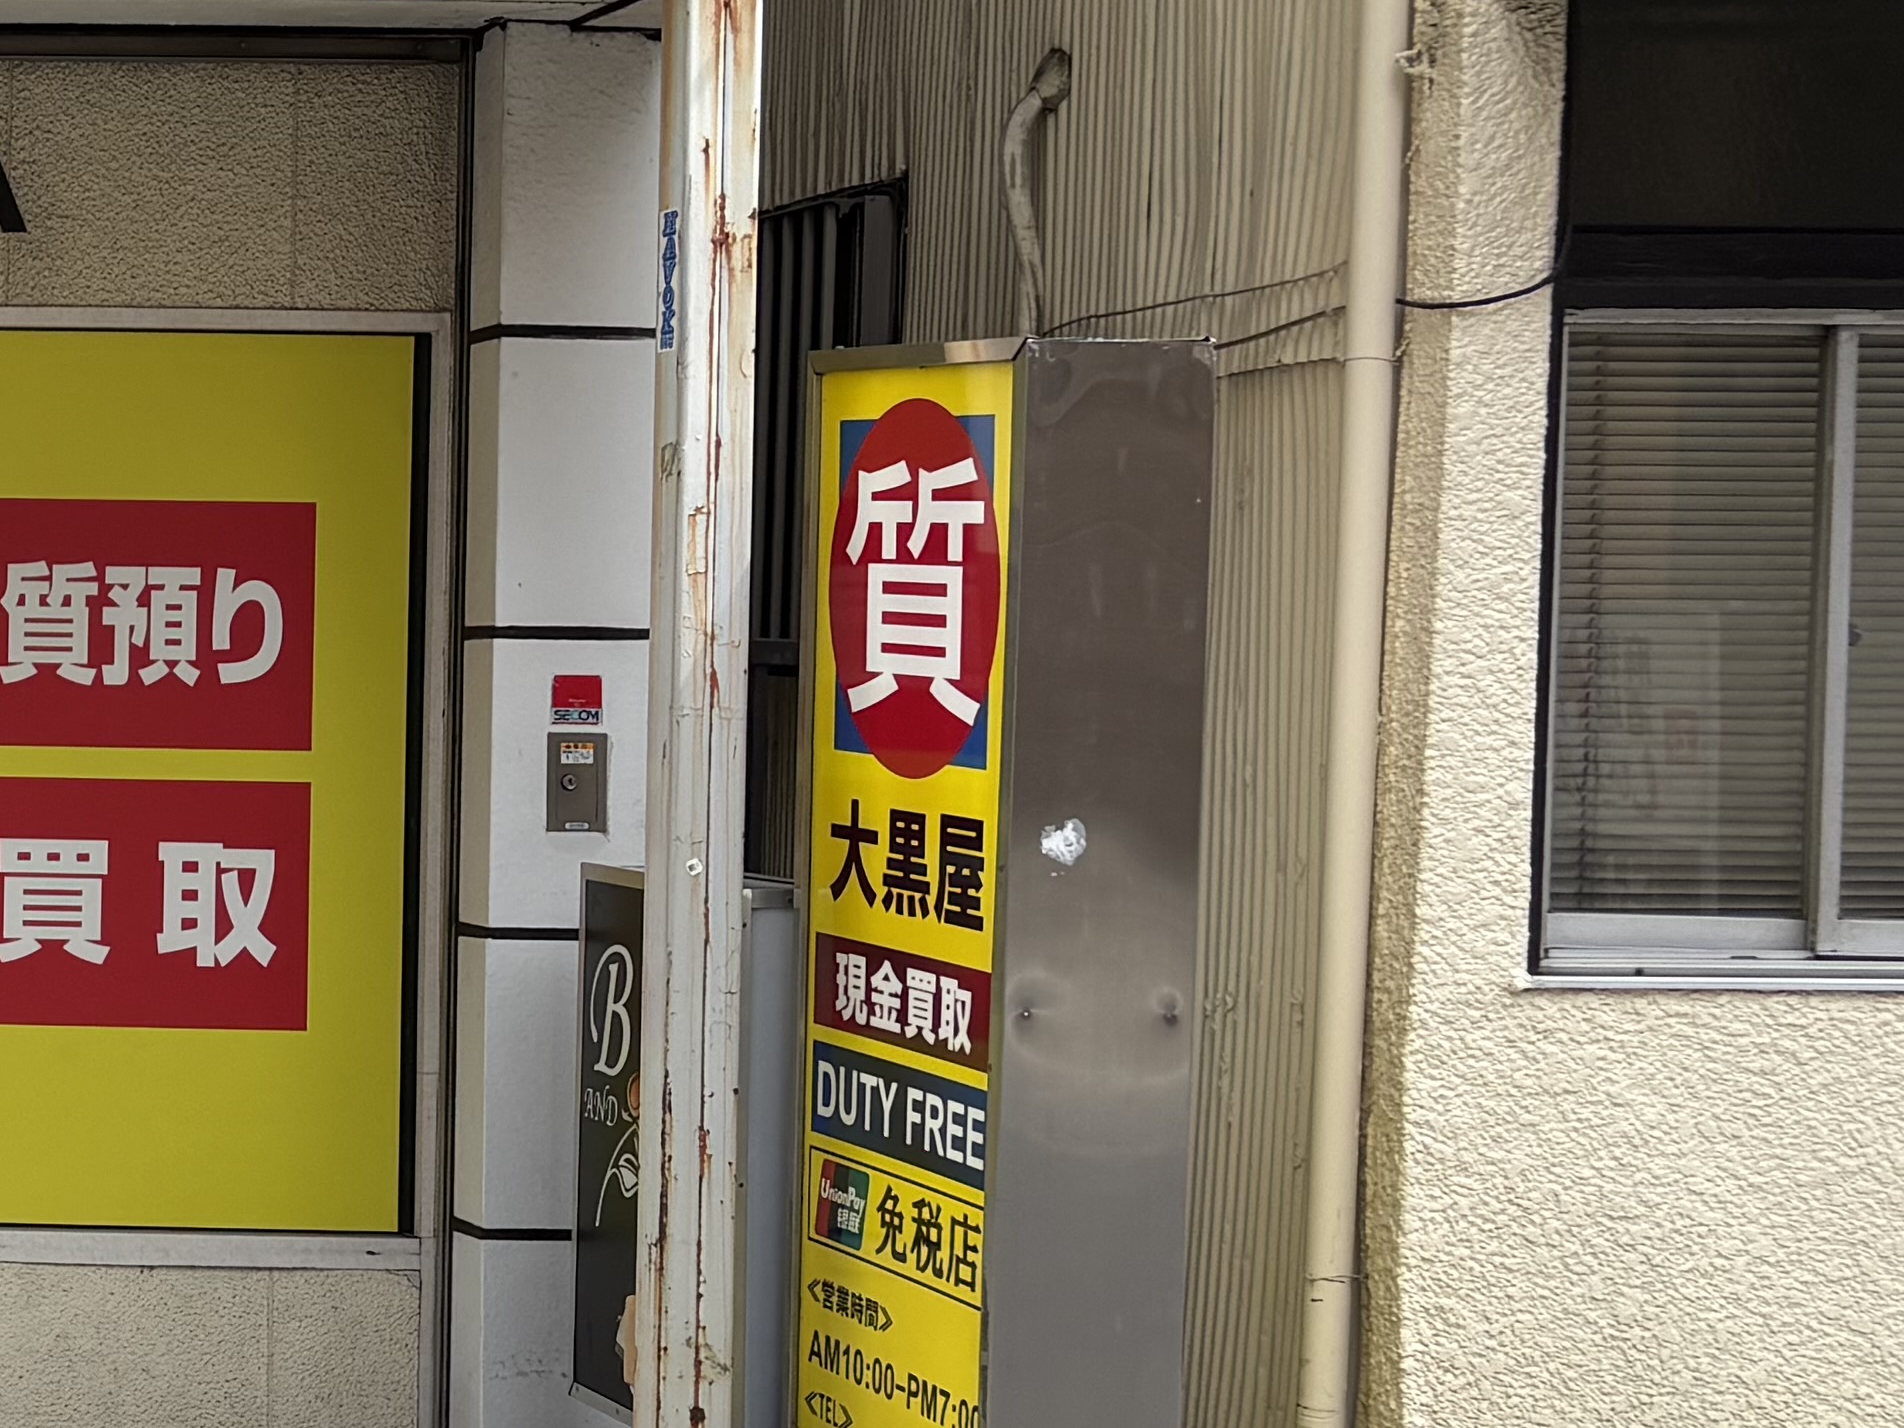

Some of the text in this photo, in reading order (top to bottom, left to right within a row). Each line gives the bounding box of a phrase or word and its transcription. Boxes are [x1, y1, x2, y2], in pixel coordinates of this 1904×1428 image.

[846, 457, 985, 726] 質
[554, 710, 599, 721] SECOM
[830, 799, 984, 932] 大黒屋
[835, 952, 972, 1056] 現金買取
[584, 1084, 619, 1127] AND
[817, 1060, 985, 1171] DUTY FREE
[820, 1177, 865, 1218] UnionPay
[875, 1184, 982, 1293] 免税店
